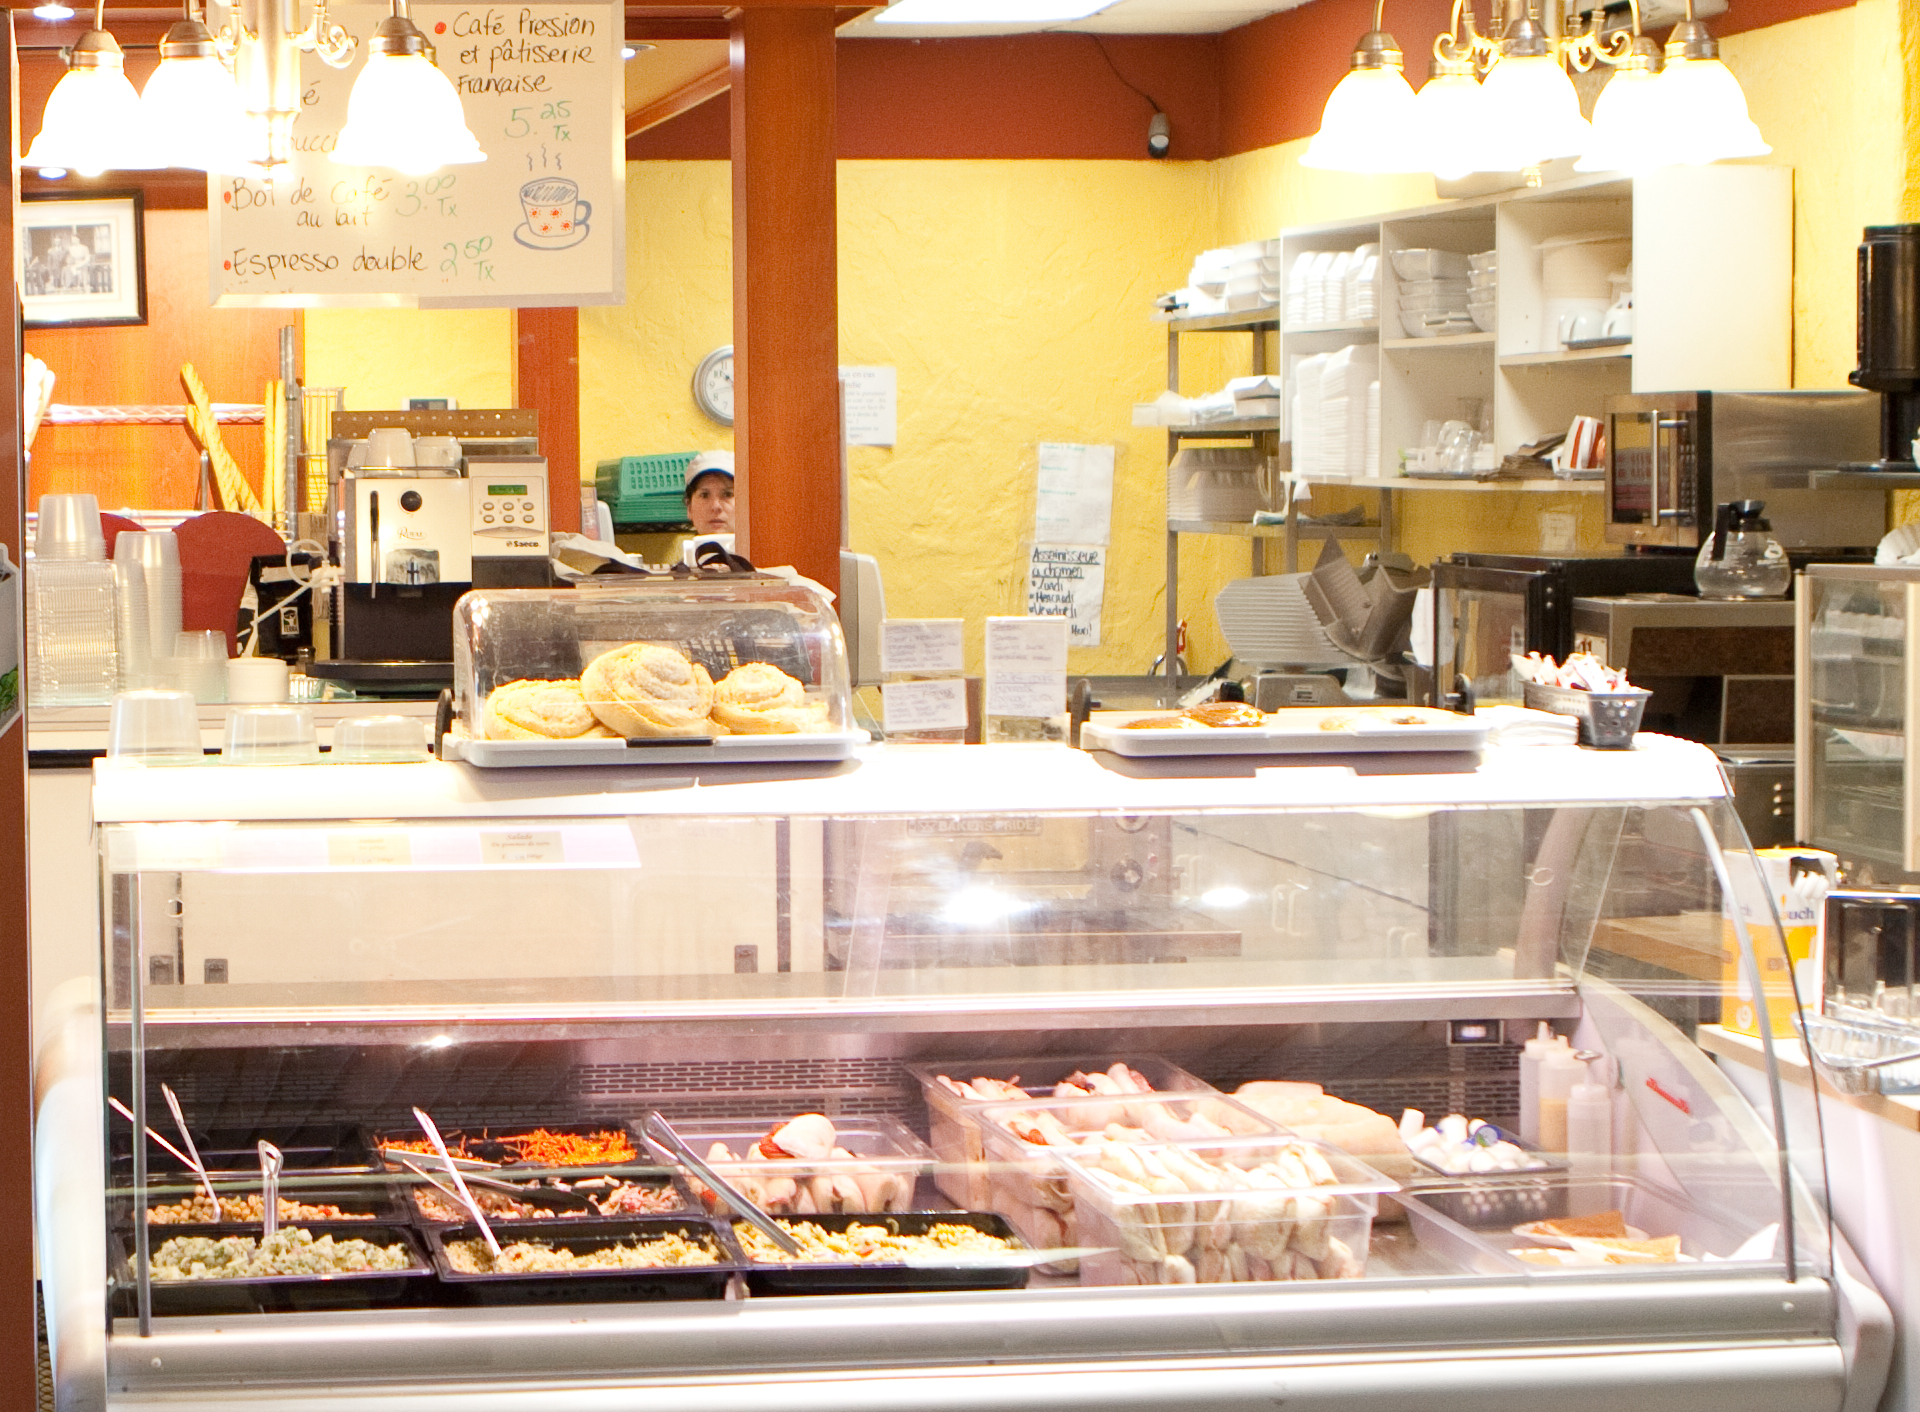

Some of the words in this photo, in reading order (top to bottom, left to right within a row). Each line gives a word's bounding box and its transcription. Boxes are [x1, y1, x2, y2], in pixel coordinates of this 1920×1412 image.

[453, 8, 505, 37] Café
[518, 8, 595, 37] Pression
[460, 45, 480, 64] et
[490, 38, 596, 73] pâtisserie
[290, 177, 316, 205] de
[330, 175, 394, 205] Café
[297, 210, 324, 228] au
[335, 206, 373, 226] lait
[233, 247, 340, 280] Espresso
[353, 245, 428, 272] double
[1779, 903, 1815, 921] ouch
